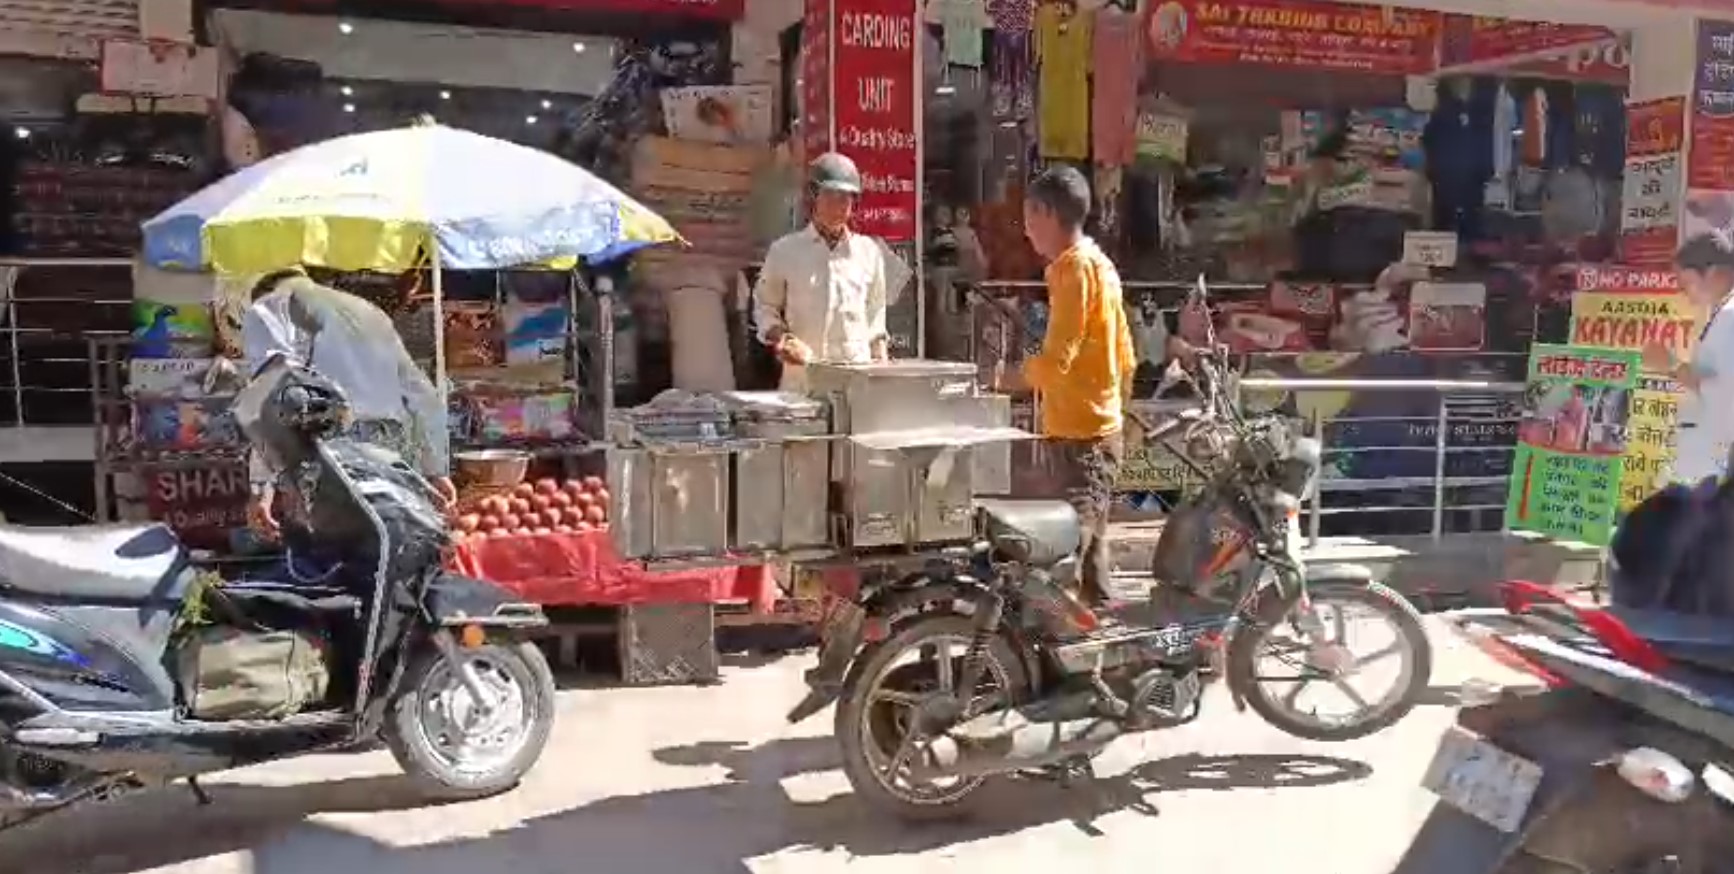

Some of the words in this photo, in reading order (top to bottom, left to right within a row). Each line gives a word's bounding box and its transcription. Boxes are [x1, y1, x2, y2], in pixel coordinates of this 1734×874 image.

[841, 13, 911, 50] CARDING
[857, 76, 895, 114] UNIT
[1599, 270, 1621, 288] NO
[1574, 316, 1695, 348] KAYANAT
